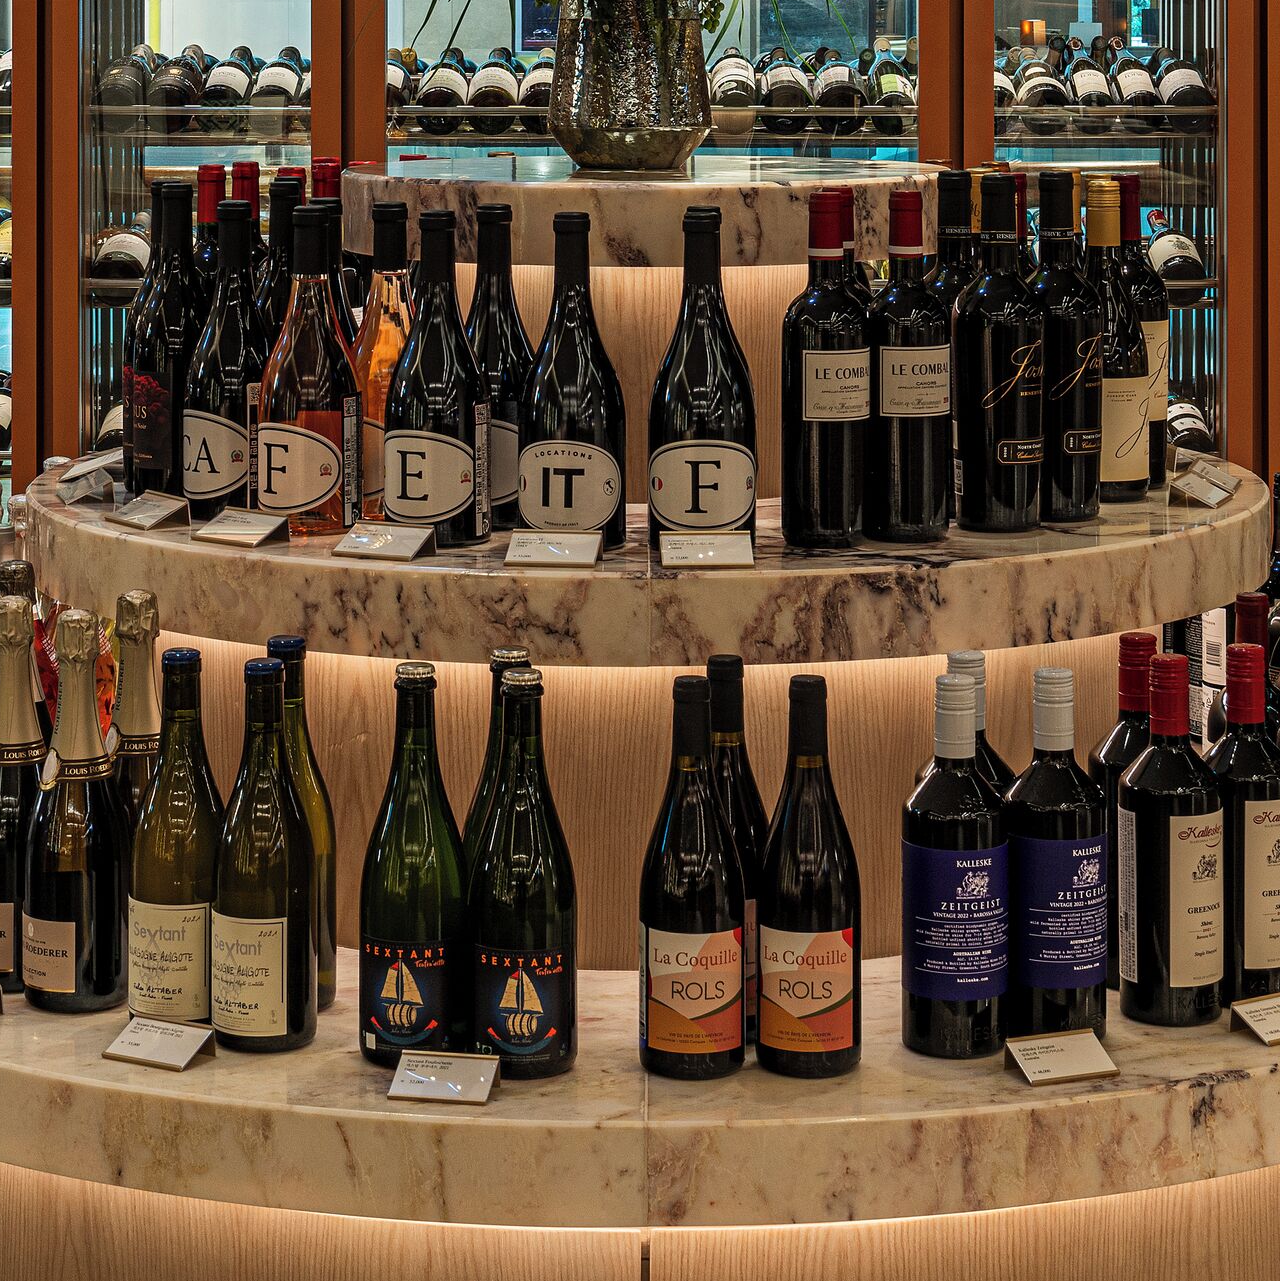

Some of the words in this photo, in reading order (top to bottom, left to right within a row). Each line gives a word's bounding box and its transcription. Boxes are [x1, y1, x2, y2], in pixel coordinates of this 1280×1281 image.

[815, 368, 831, 380] LE
[892, 364, 907, 376] LE
[534, 449, 594, 461] LOCATIONS
[263, 442, 289, 495] F
[396, 449, 429, 502] E
[542, 467, 585, 509] IT
[684, 460, 721, 514] F
[54, 680, 63, 735] ROEDERER
[124, 741, 147, 750] LOUIS
[3, 749, 26, 760] LOUIS
[65, 766, 88, 775] LOUIS
[1072, 845, 1102, 857] KALLESKE
[956, 858, 992, 868] KALLESKE
[1058, 884, 1107, 900] ZEITGEIST
[941, 898, 1001, 911] ZEITGEIST
[181, 915, 201, 923] 2021
[933, 911, 956, 919] VINTAGE
[973, 910, 993, 918] BAROSSA
[133, 921, 186, 945] Sextant
[258, 930, 278, 938] 2021
[26, 942, 68, 958] ROEDERER
[214, 933, 262, 959] Sextant
[365, 943, 444, 959] SEXTANT
[482, 954, 563, 967] SEXTANT
[654, 948, 671, 965] La
[675, 949, 738, 969] Coquille
[764, 946, 779, 962] La
[782, 950, 847, 969] Coquille
[146, 985, 183, 995] ALTABER
[671, 981, 725, 1001] ROLS
[779, 979, 833, 1000] ROLS
[225, 999, 259, 1010] ALTABER
